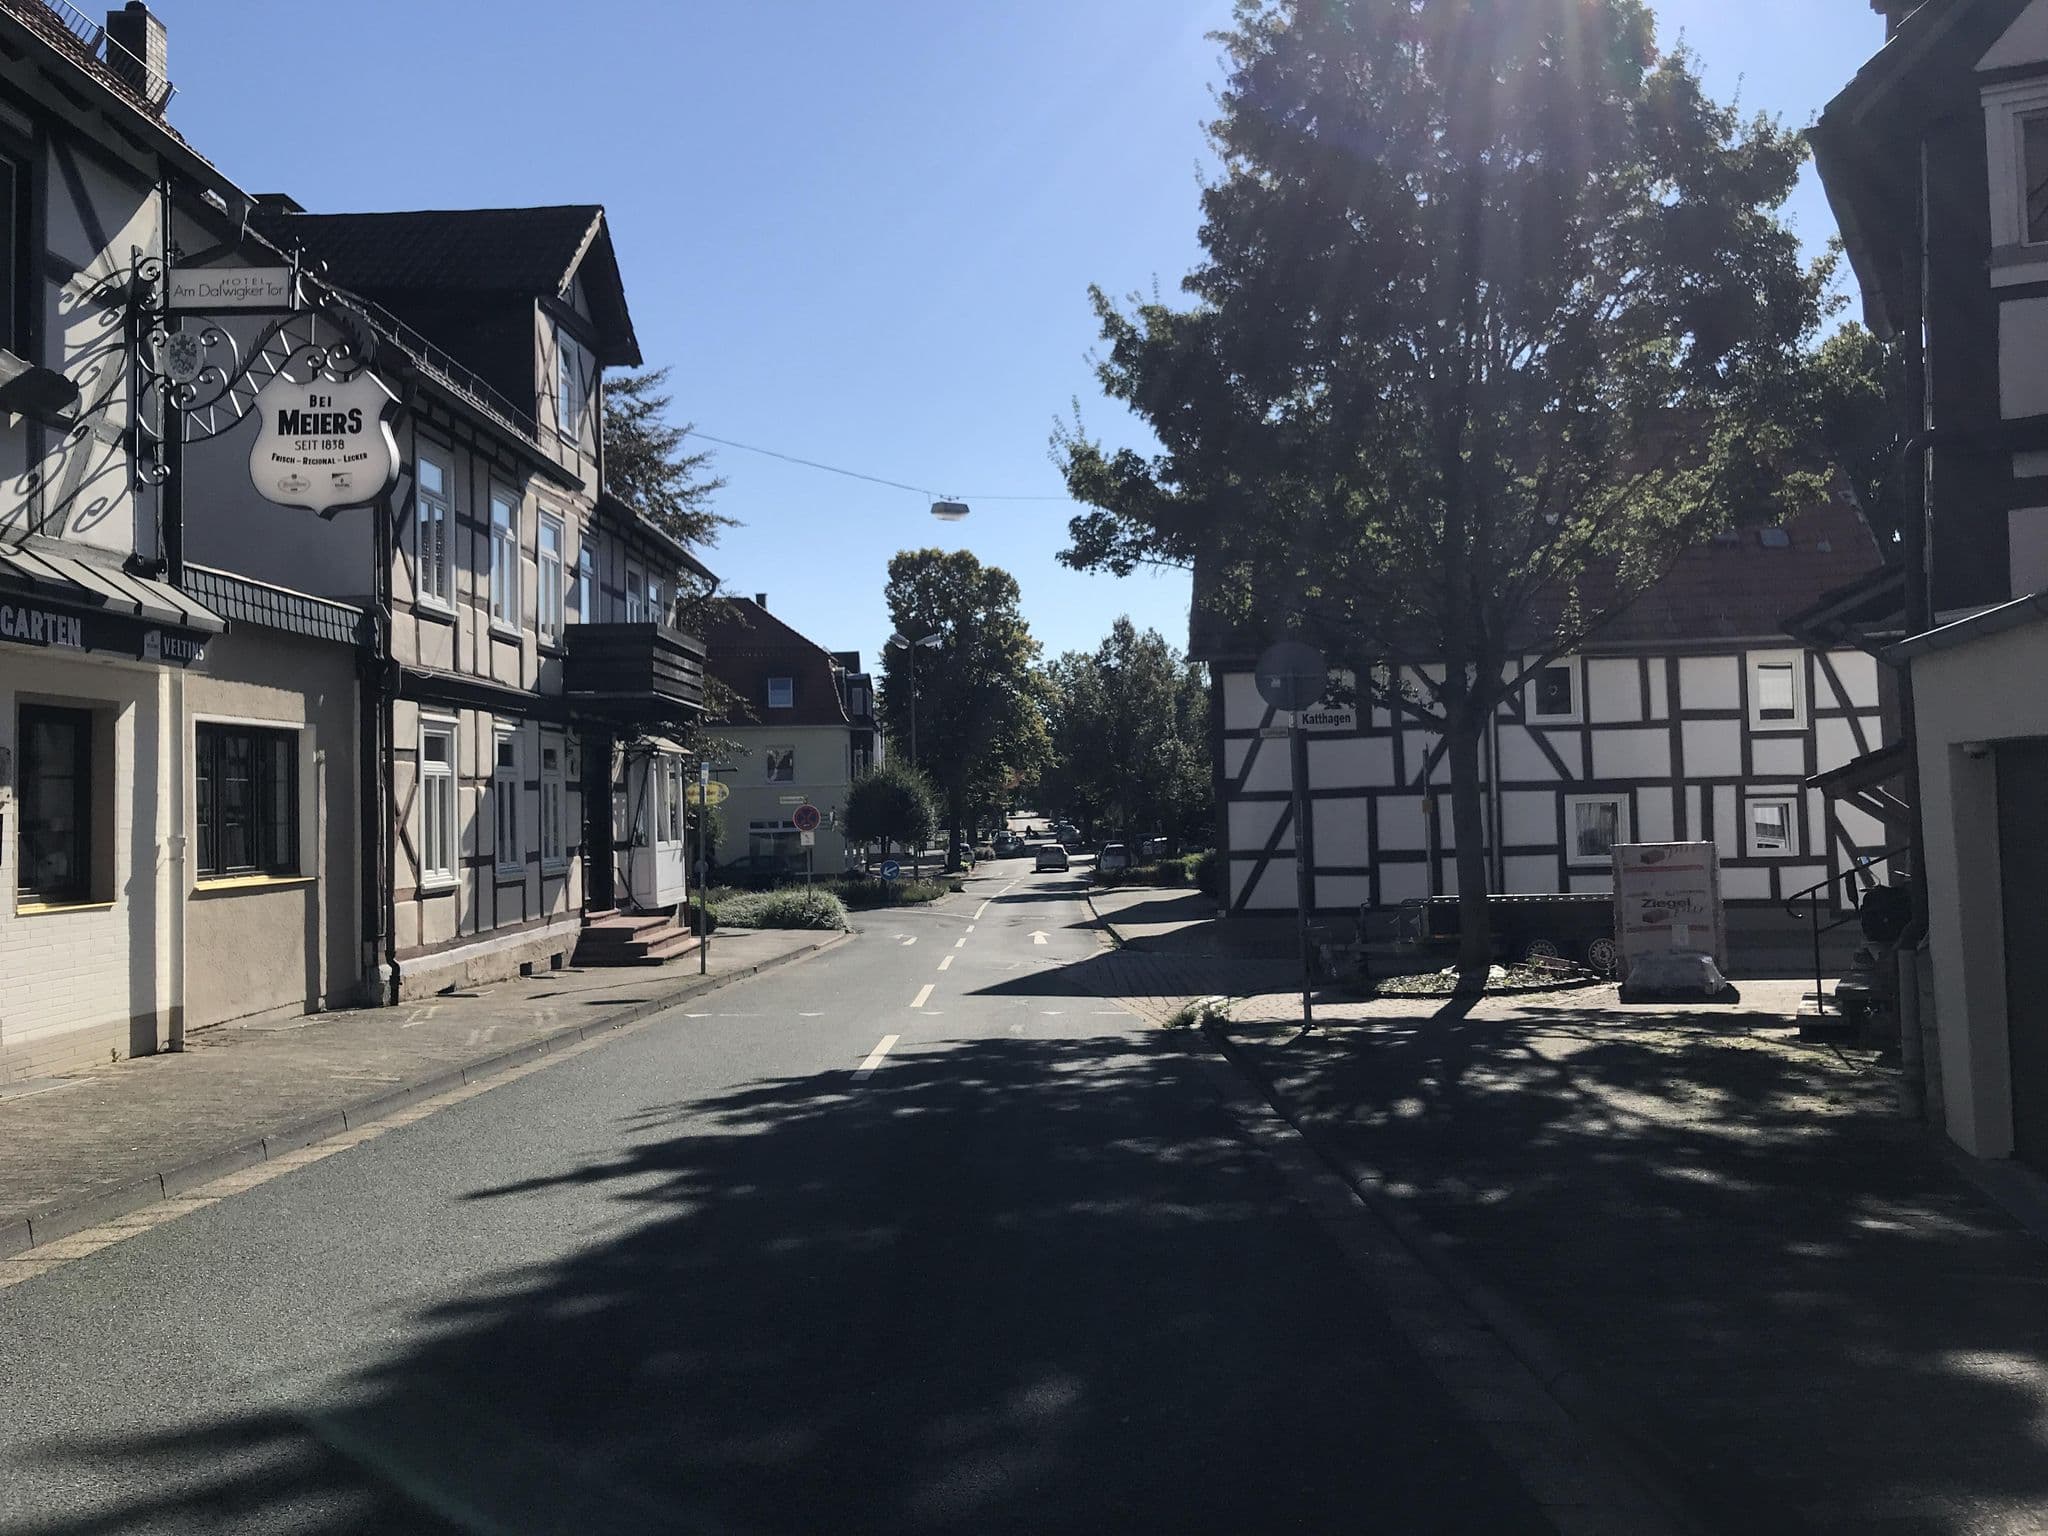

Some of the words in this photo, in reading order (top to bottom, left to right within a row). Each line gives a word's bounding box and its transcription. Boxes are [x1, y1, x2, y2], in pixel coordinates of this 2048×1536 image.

[222, 277, 264, 285] HOTEL
[174, 284, 195, 297] Am
[199, 283, 263, 301] Dalwigker
[266, 282, 283, 296] Tor
[309, 394, 332, 408] BEI
[278, 408, 363, 435] MEIERS
[294, 439, 318, 451] SEIT
[321, 439, 345, 450] 1838
[271, 452, 296, 464] FRISCH
[302, 457, 336, 465] REGIONAL
[343, 452, 368, 463] LECKER
[0, 605, 82, 647] GARTEN
[164, 636, 205, 661] VELTINS
[1302, 713, 1351, 726] Katthagen
[1641, 896, 1691, 909] Ziegel
